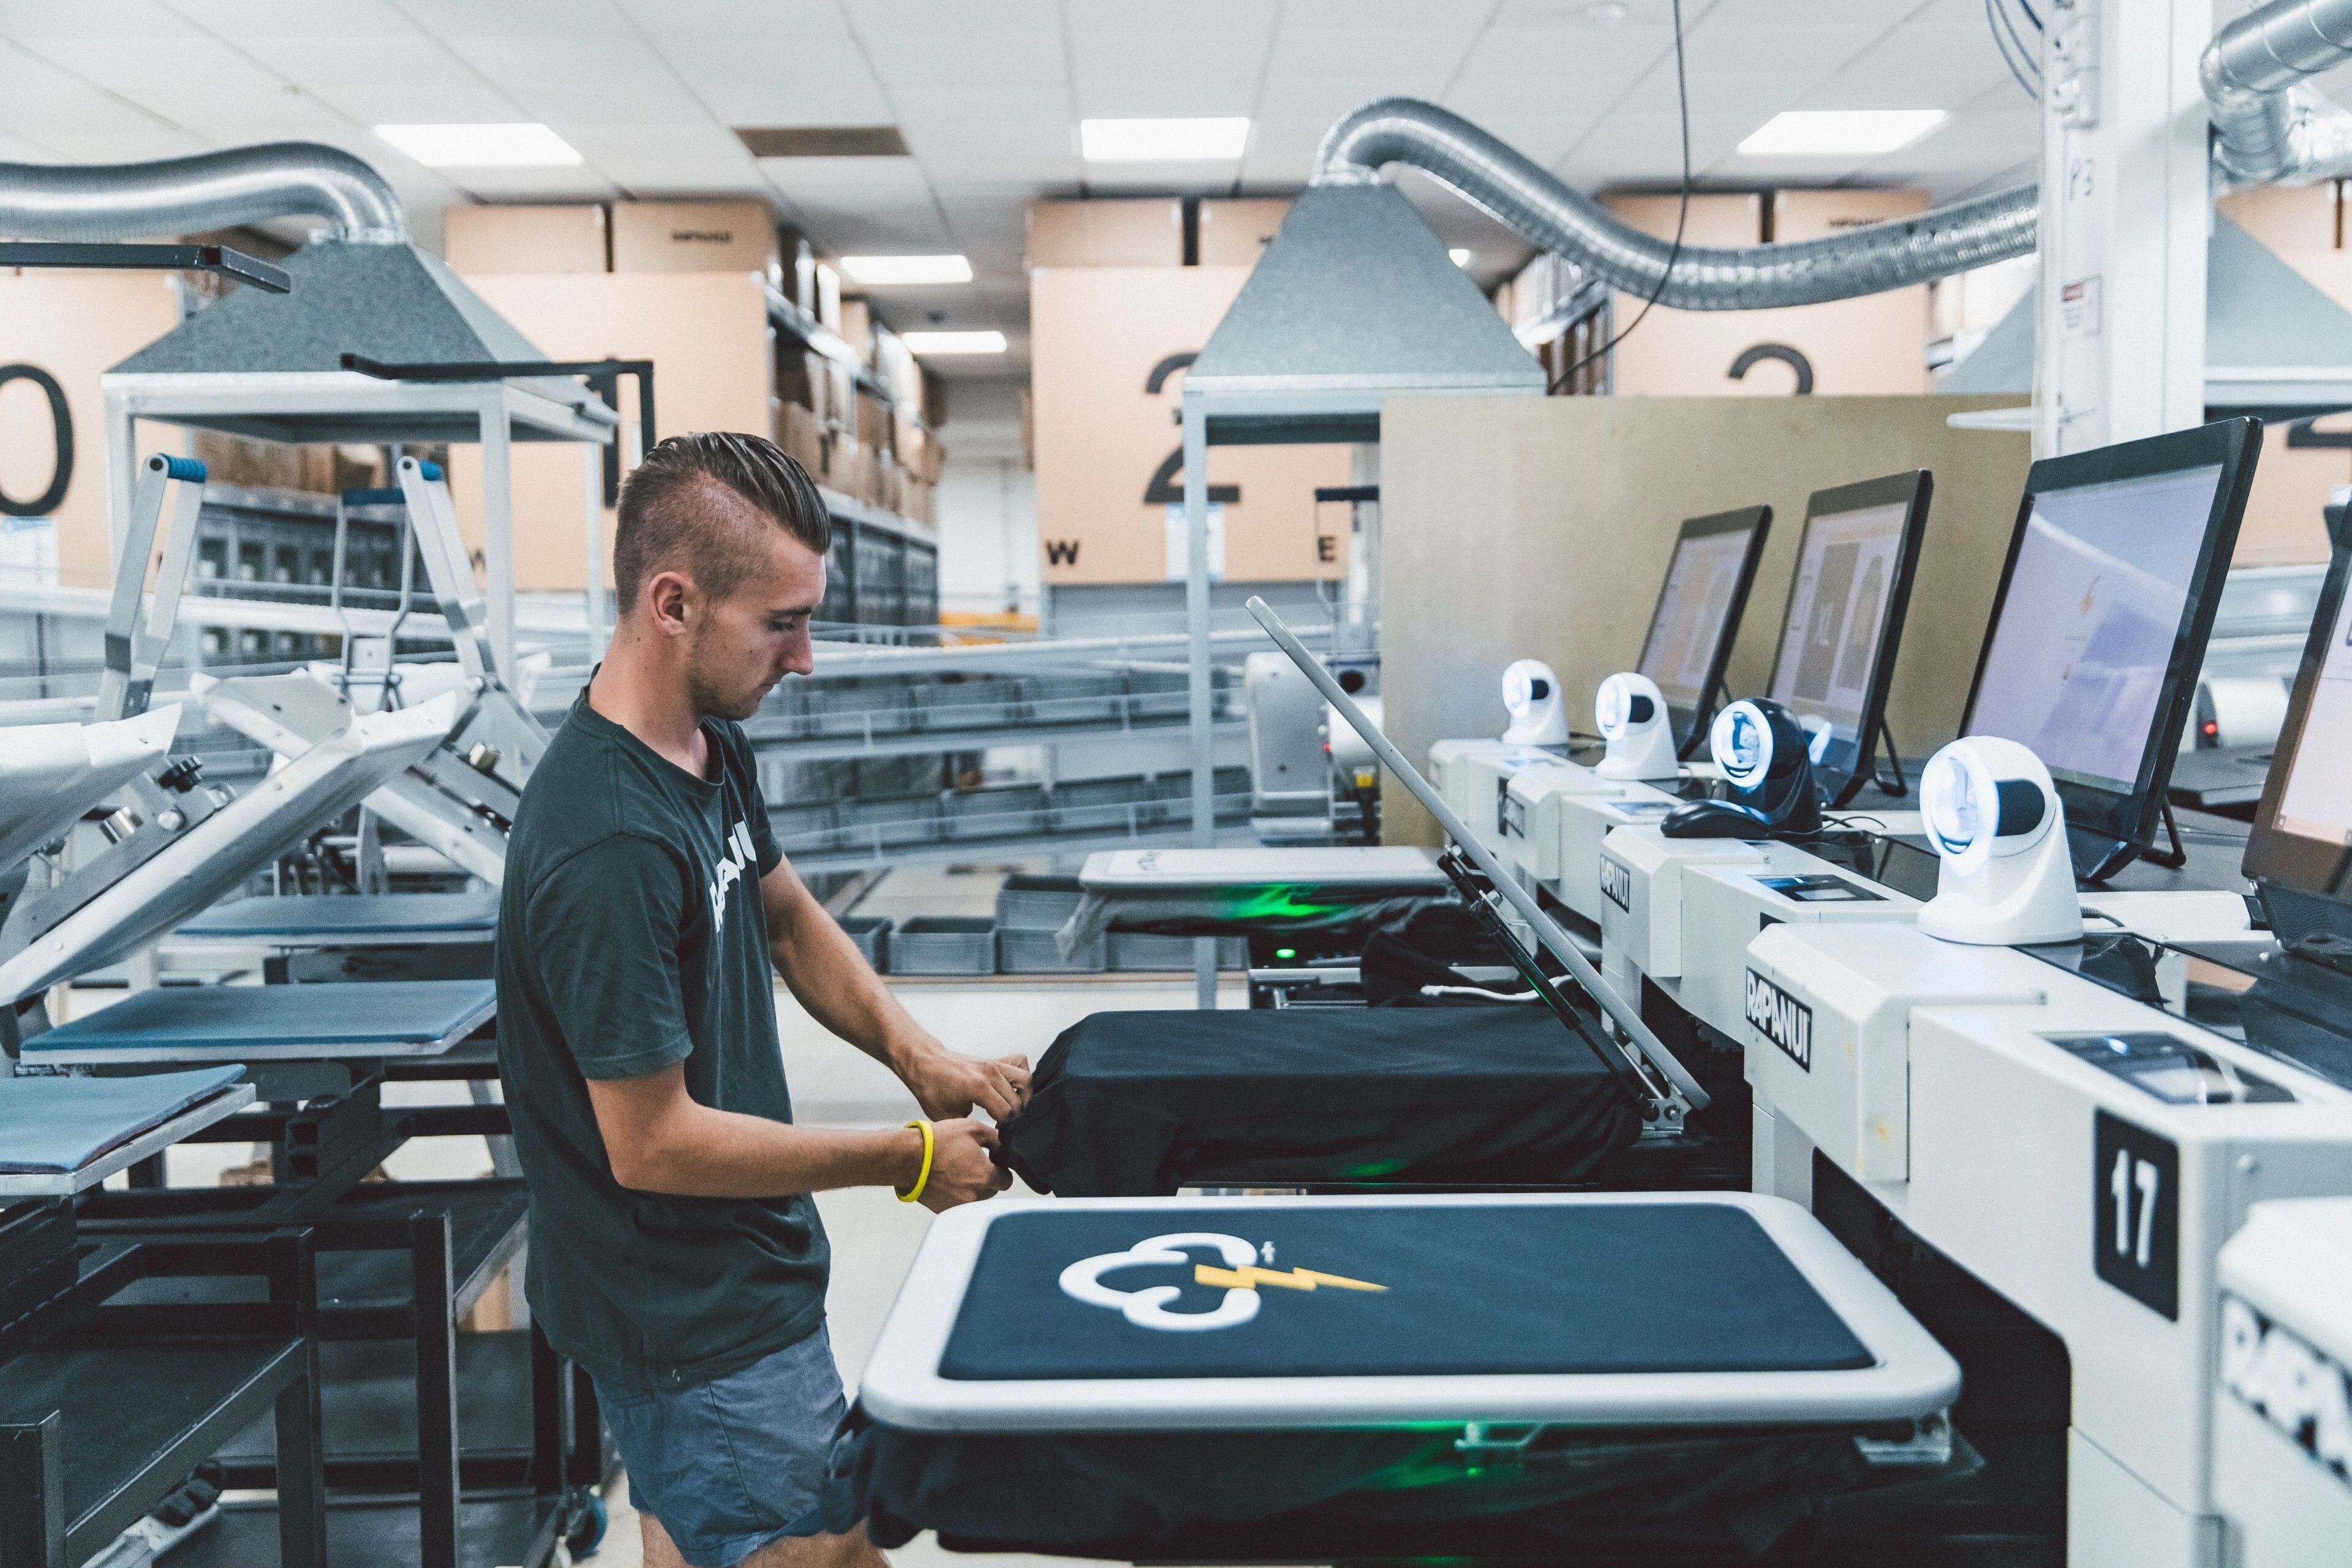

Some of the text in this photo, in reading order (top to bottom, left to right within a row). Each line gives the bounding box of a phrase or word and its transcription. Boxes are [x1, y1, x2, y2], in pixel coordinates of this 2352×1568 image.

[1046, 540, 1079, 566] W
[1318, 536, 1336, 562] E
[1746, 970, 1809, 1063] RAPANUI
[2111, 1148, 2160, 1268] 17
